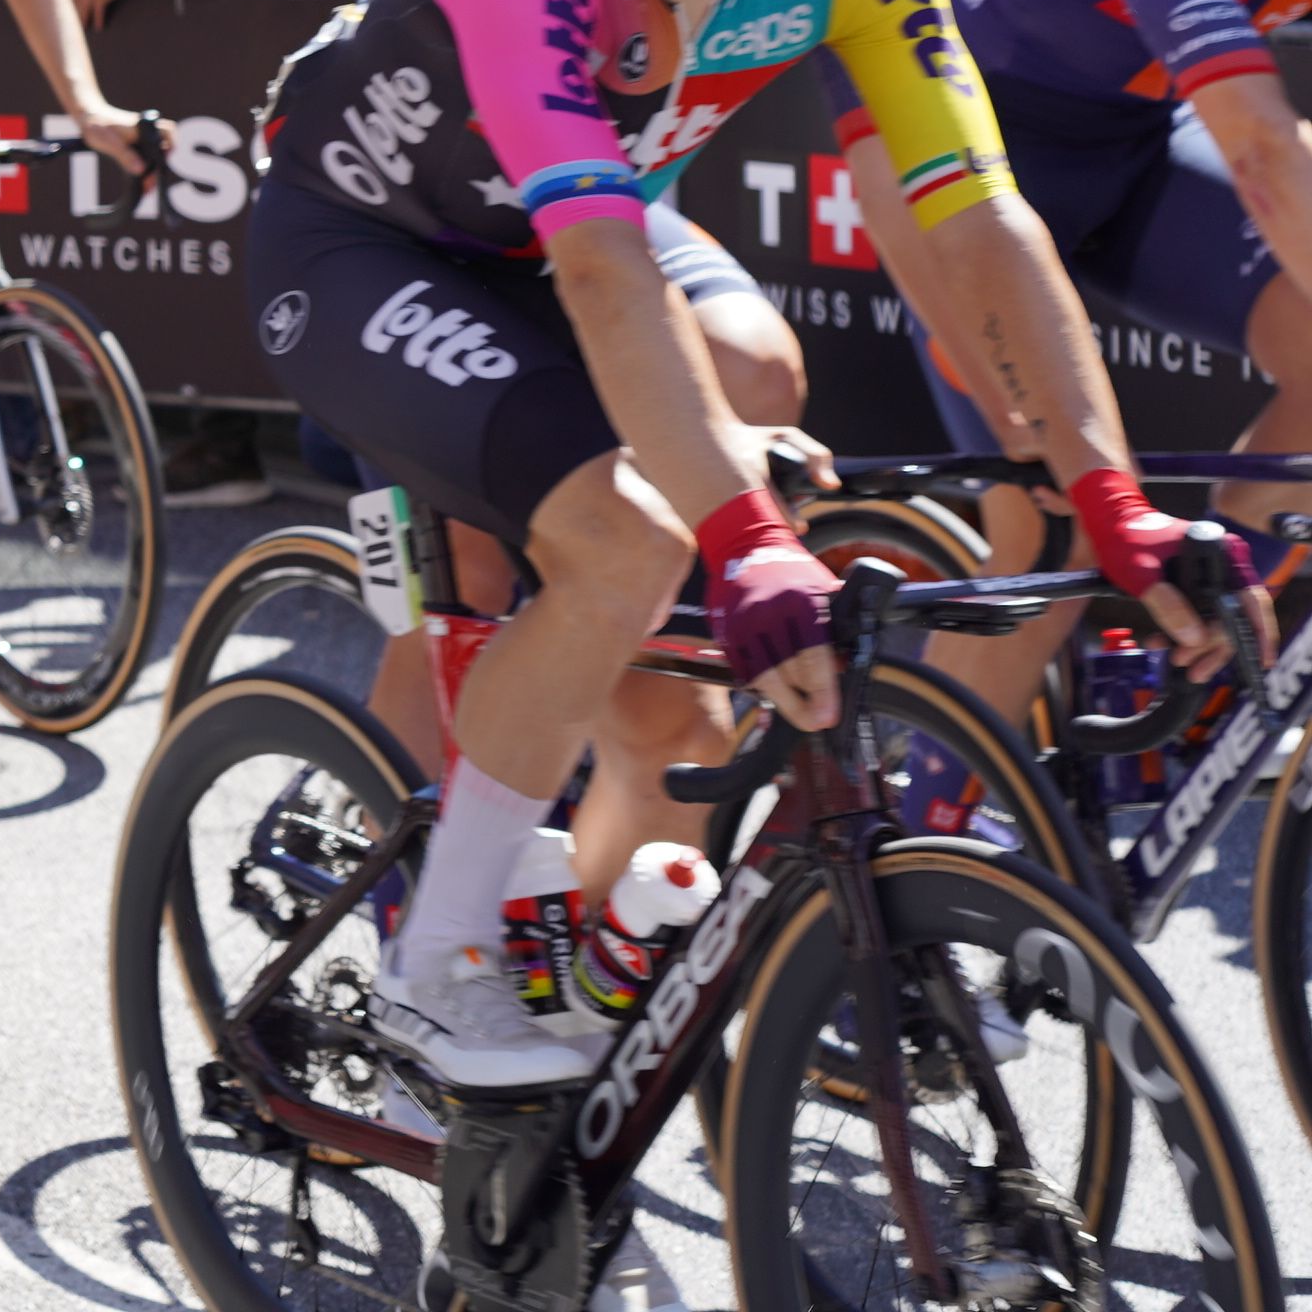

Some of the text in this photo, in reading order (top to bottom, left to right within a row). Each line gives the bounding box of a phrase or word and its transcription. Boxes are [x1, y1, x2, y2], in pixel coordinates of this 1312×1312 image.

[702, 4, 814, 61] caps
[21, 233, 233, 275] WATCHES
[360, 279, 519, 387] lotto
[576, 863, 775, 1161] ORBEA
